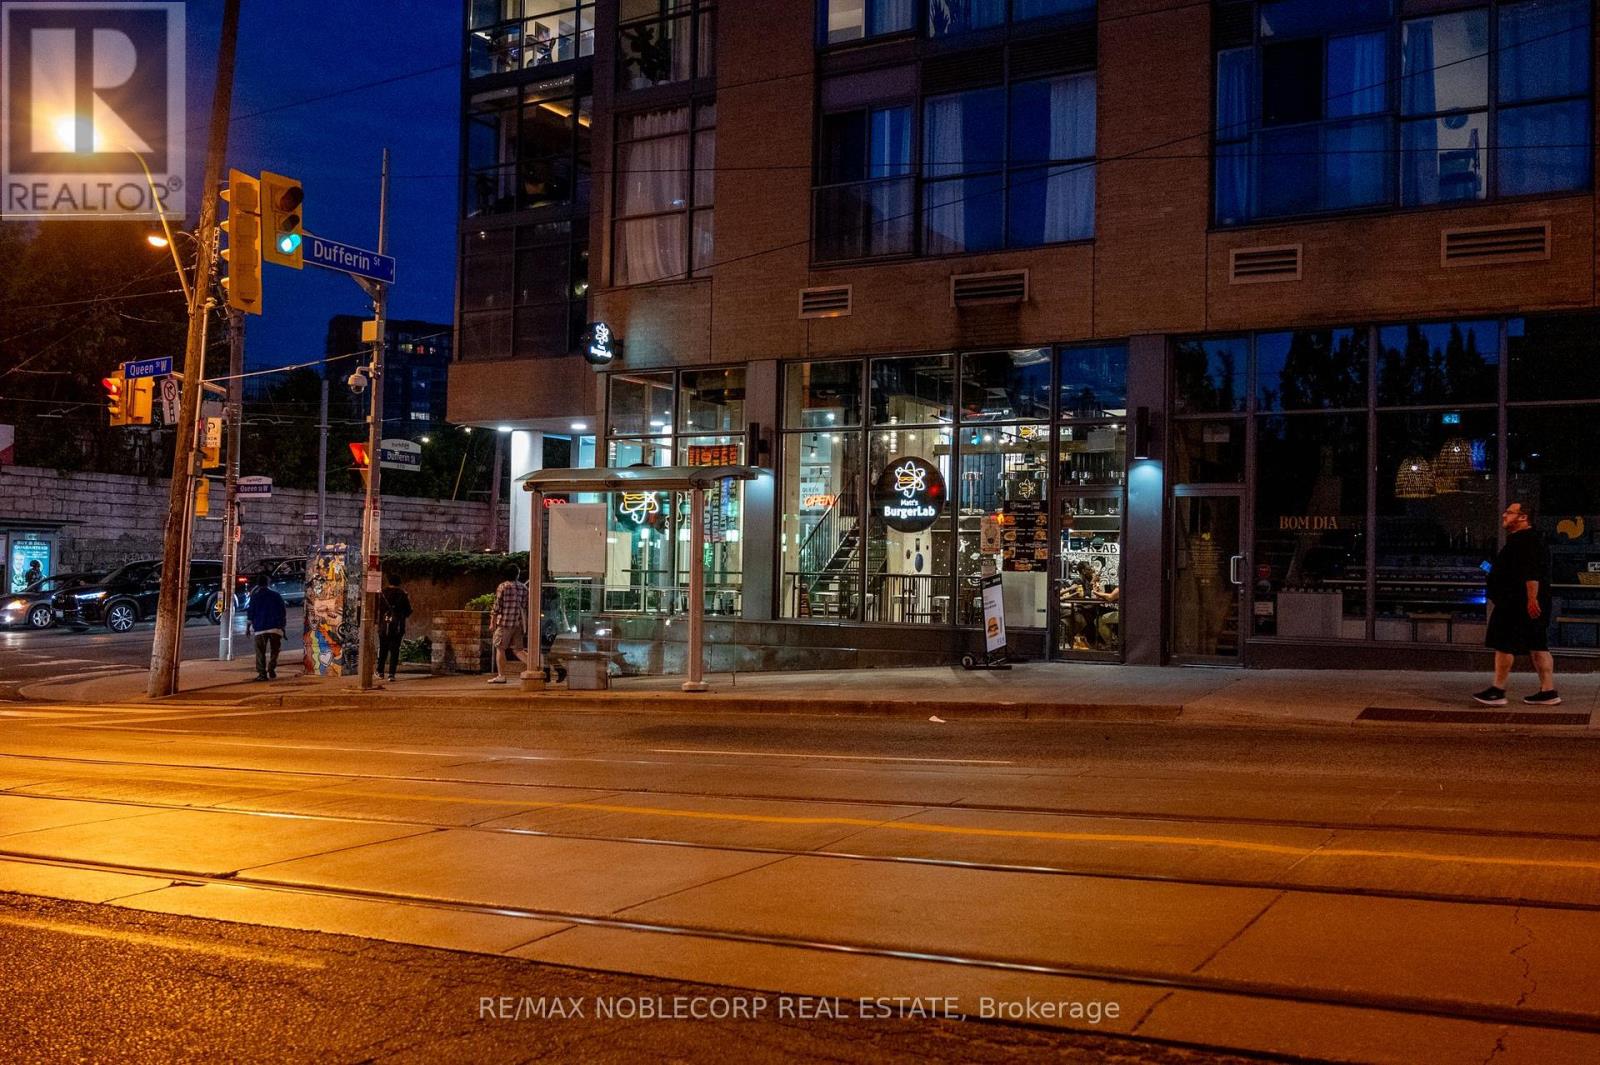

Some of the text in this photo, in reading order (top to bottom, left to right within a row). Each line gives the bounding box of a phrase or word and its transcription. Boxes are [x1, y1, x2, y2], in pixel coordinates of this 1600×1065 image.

[313, 240, 381, 271] Dufferin St
[130, 364, 154, 376] Queen
[160, 360, 167, 372] W
[804, 495, 835, 506] OPEN
[884, 505, 936, 519] BurgerLab
[1280, 515, 1339, 529] BOM DIA
